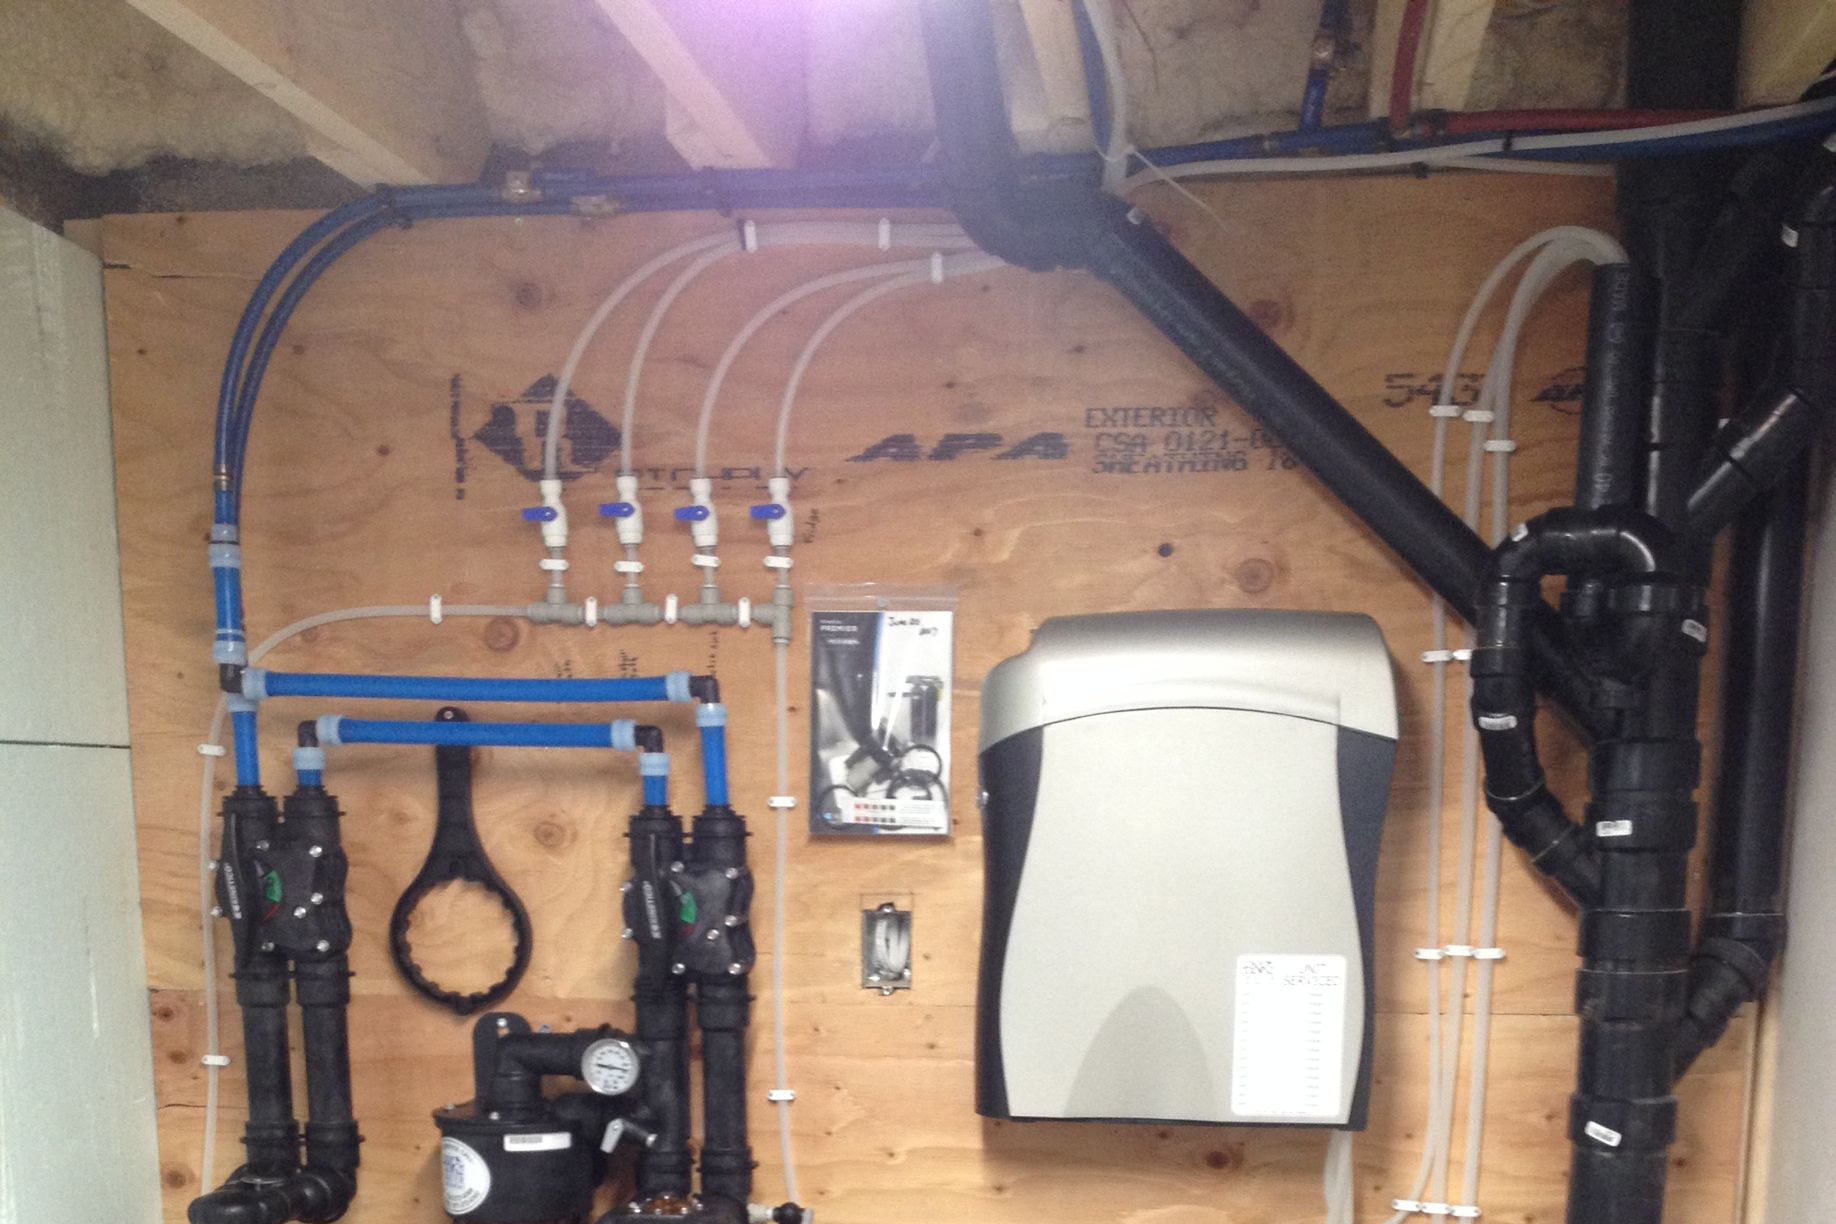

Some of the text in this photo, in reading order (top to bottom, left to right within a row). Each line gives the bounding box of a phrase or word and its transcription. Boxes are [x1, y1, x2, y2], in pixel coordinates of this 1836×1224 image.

[1084, 407, 1218, 428] EXTERIOR
[845, 432, 1069, 461] APA
[1094, 432, 1148, 453] CSA
